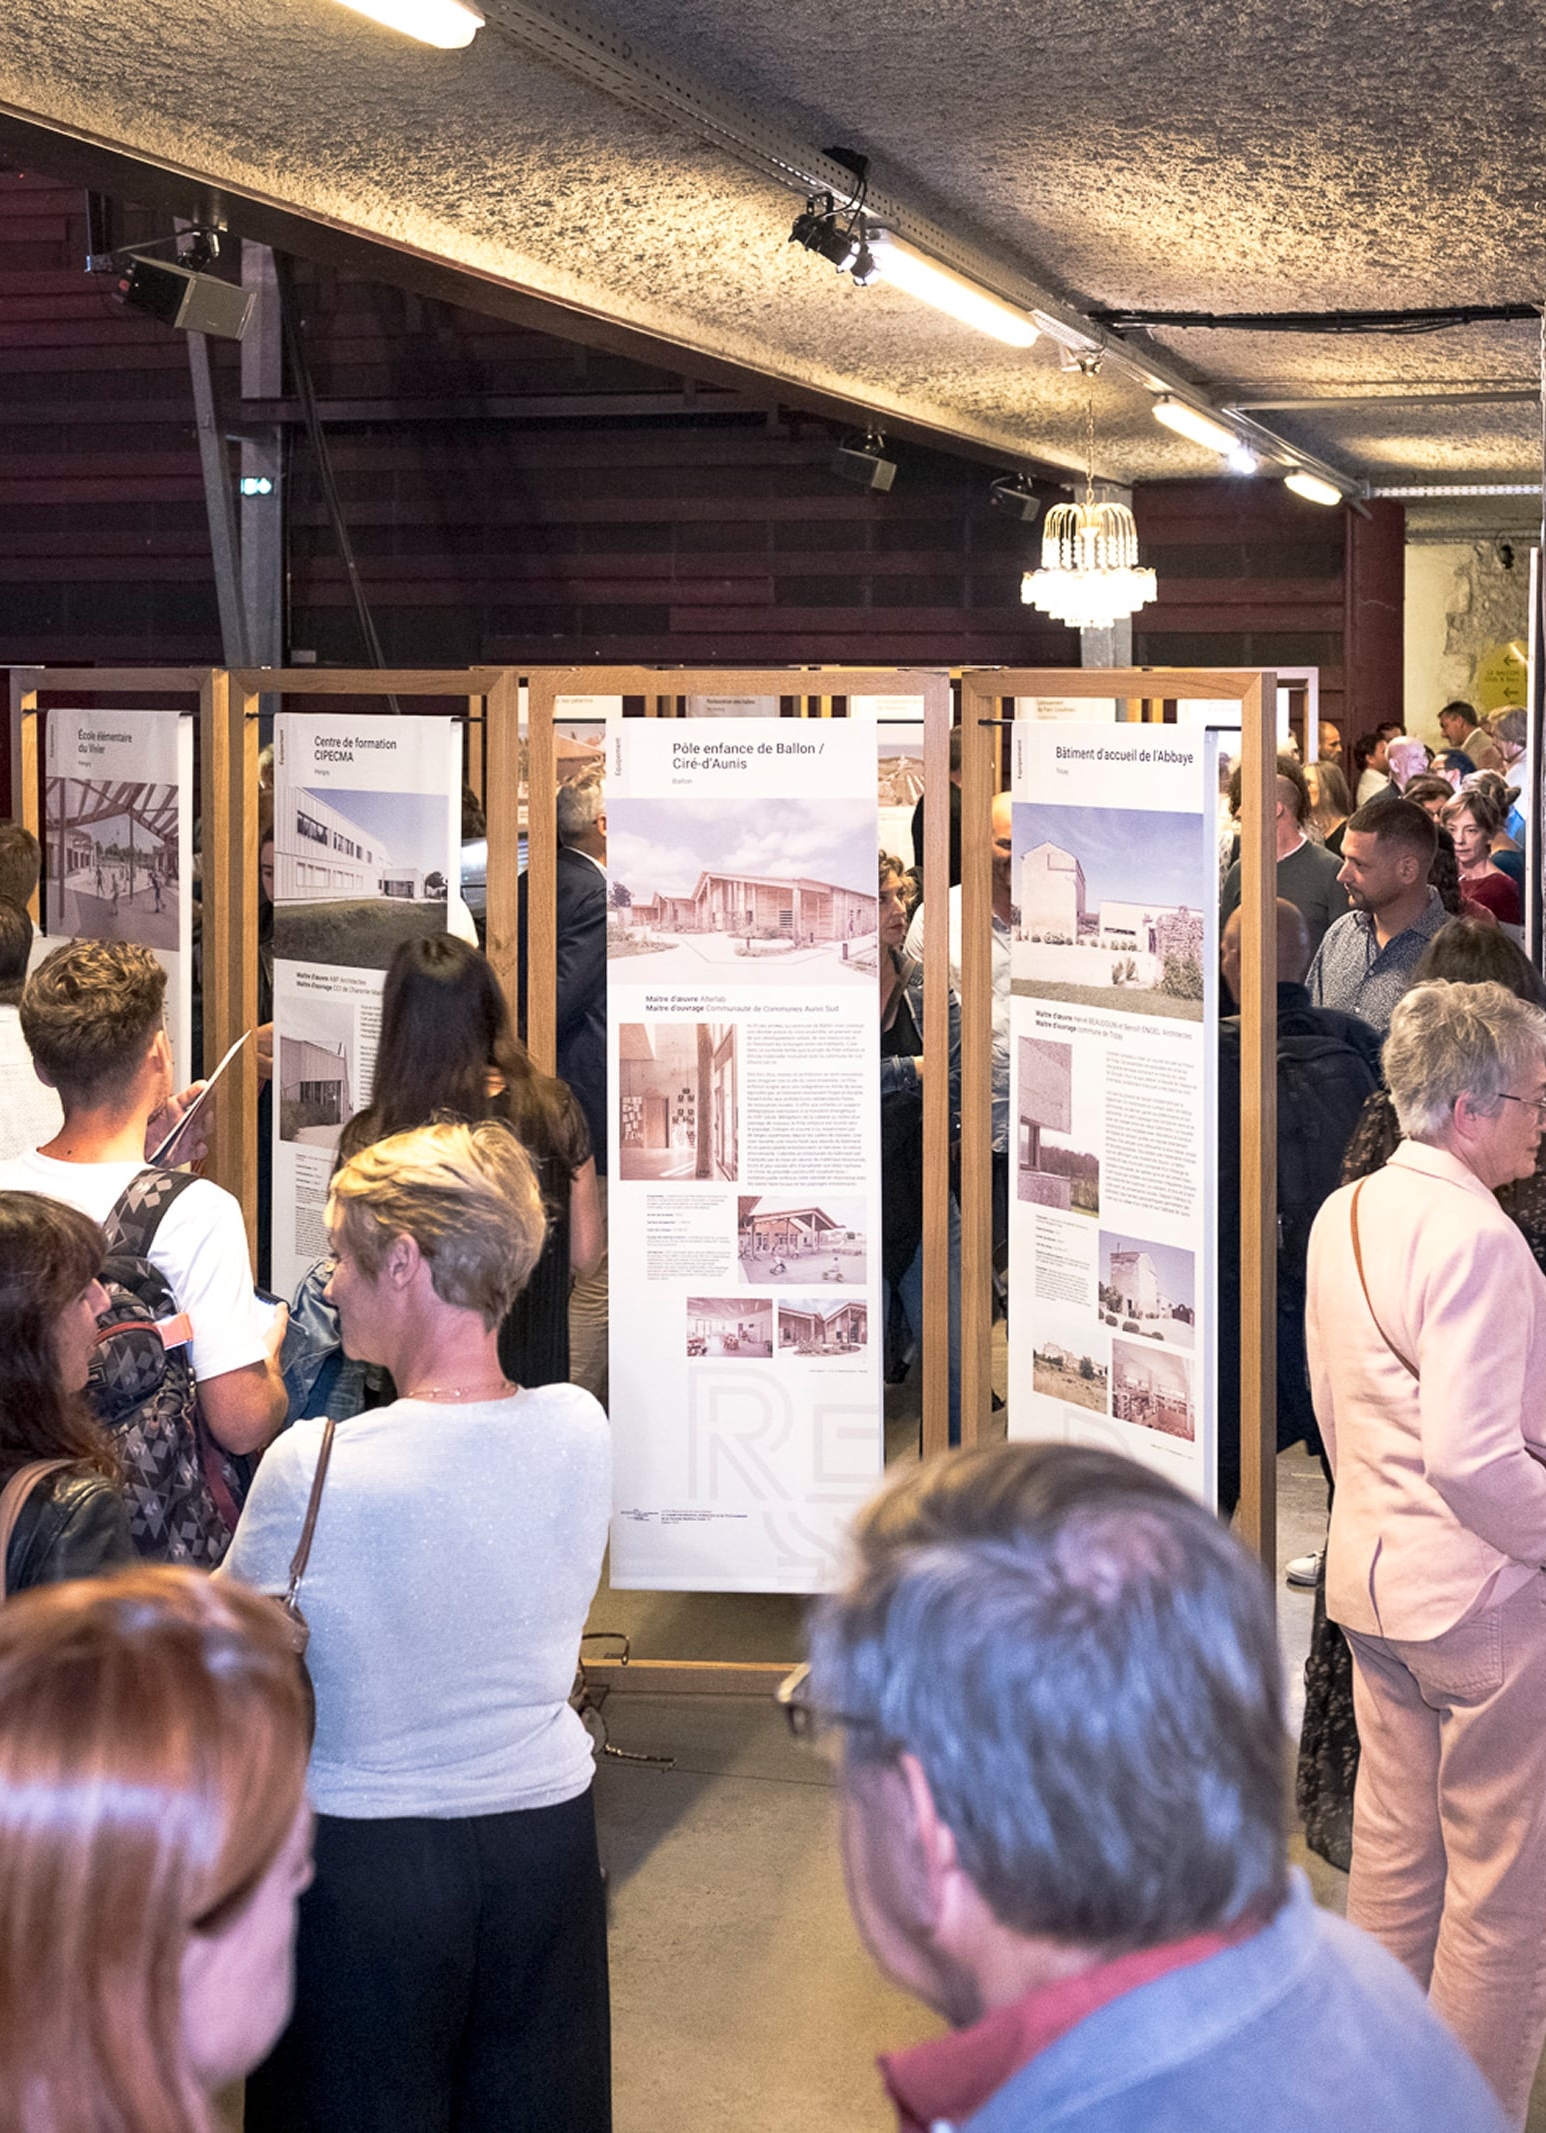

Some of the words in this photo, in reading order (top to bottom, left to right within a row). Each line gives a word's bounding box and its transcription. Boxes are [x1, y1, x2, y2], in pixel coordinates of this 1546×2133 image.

[78, 728, 96, 741] École
[78, 743, 88, 753] du
[314, 735, 341, 748] Centre
[343, 737, 354, 748] de
[355, 737, 397, 750] formation
[672, 742, 700, 755] Pôle
[703, 742, 753, 755] enfance
[757, 742, 772, 755] de
[776, 742, 815, 755] Ballon
[818, 742, 825, 756] /
[314, 750, 354, 762] CIPECMA
[1056, 745, 1095, 760] Bâtiment
[1097, 747, 1137, 762] d'accueil
[1139, 749, 1151, 762] de
[1152, 749, 1194, 767] l'Abbaye
[672, 757, 747, 770] Ciré-d'Aunis
[645, 995, 669, 1003] Maître
[645, 1004, 669, 1012] Maître
[670, 1004, 704, 1013] d'ouvrage
[753, 1005, 762, 1013] de
